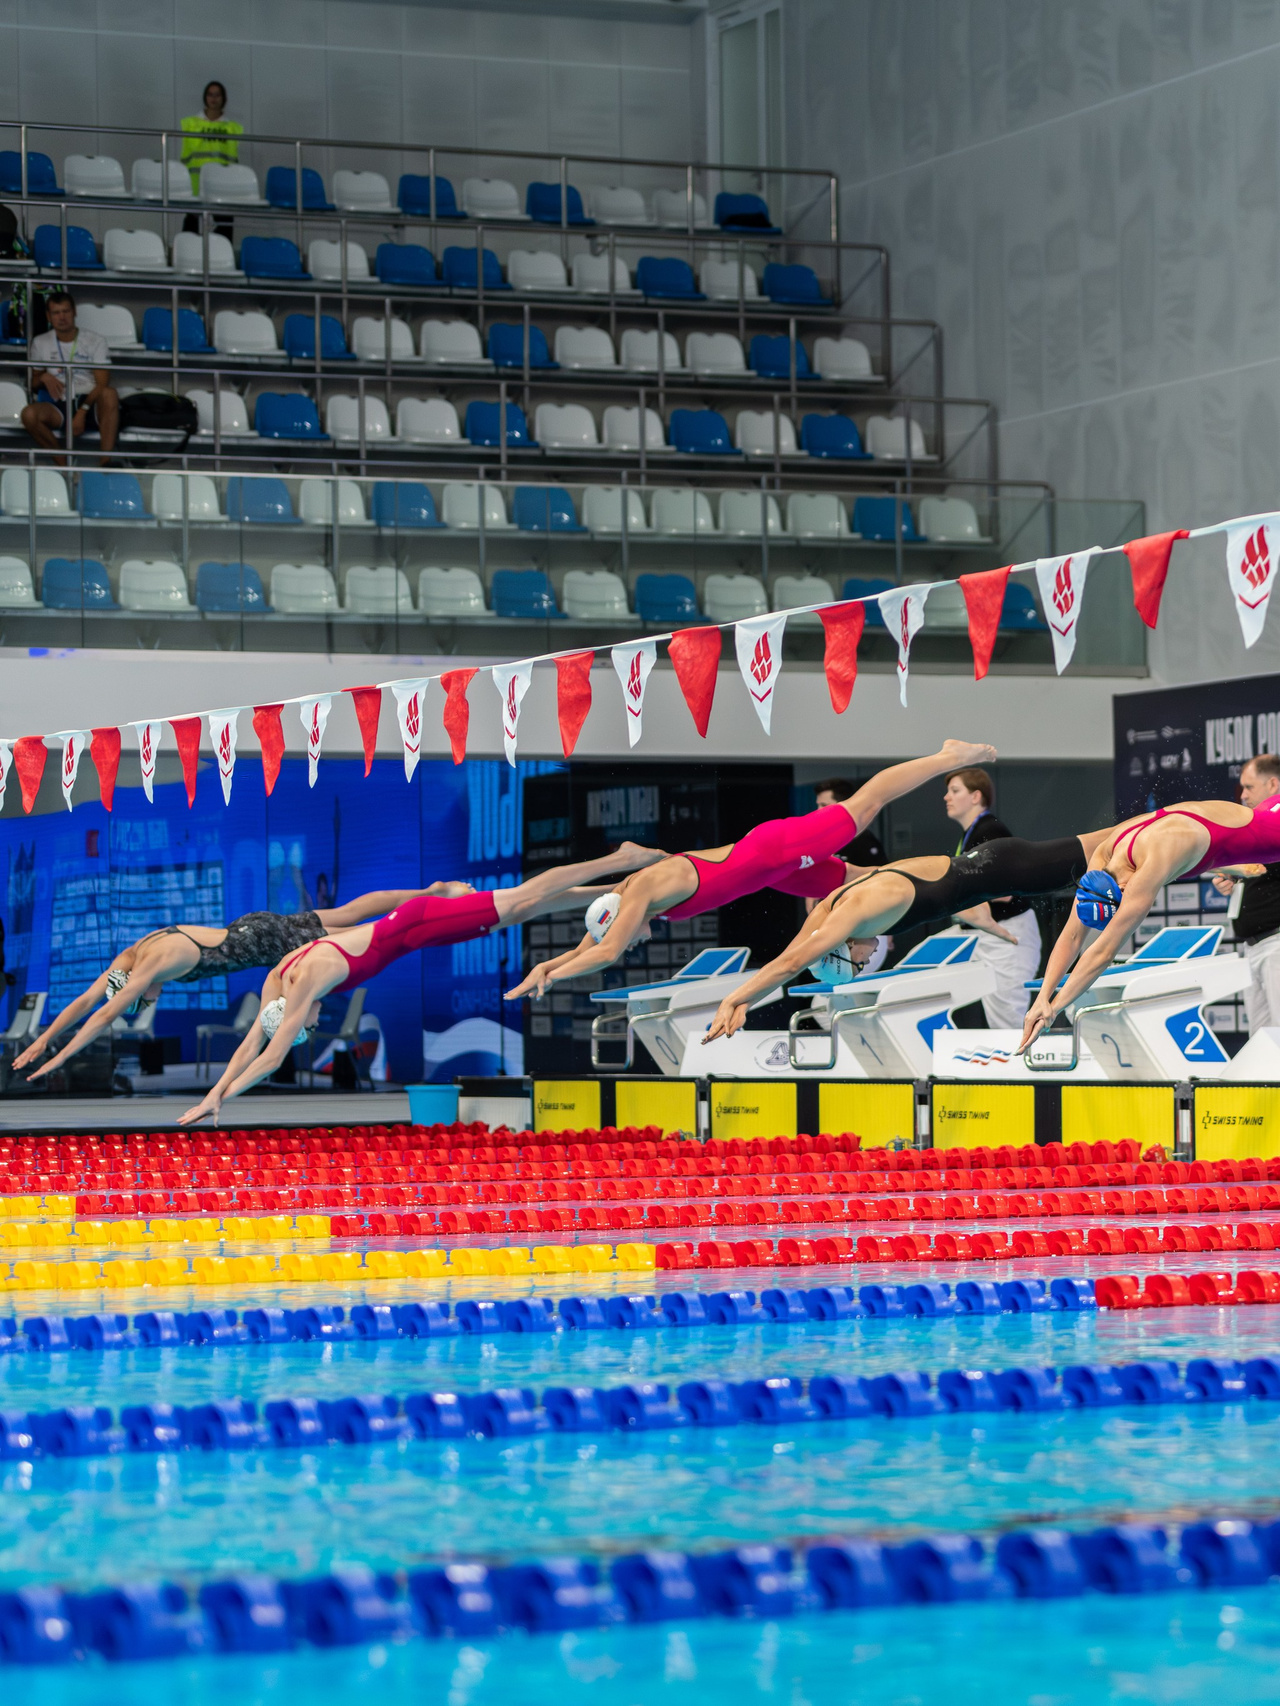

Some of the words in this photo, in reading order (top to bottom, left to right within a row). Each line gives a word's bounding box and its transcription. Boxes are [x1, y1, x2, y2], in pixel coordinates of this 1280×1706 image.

[1206, 715, 1253, 765] КУБОК
[1101, 1033, 1133, 1067] 2
[1184, 1022, 1205, 1055] 2
[1212, 1115, 1237, 1125] SWISS
[1238, 1115, 1264, 1126] TIMING
